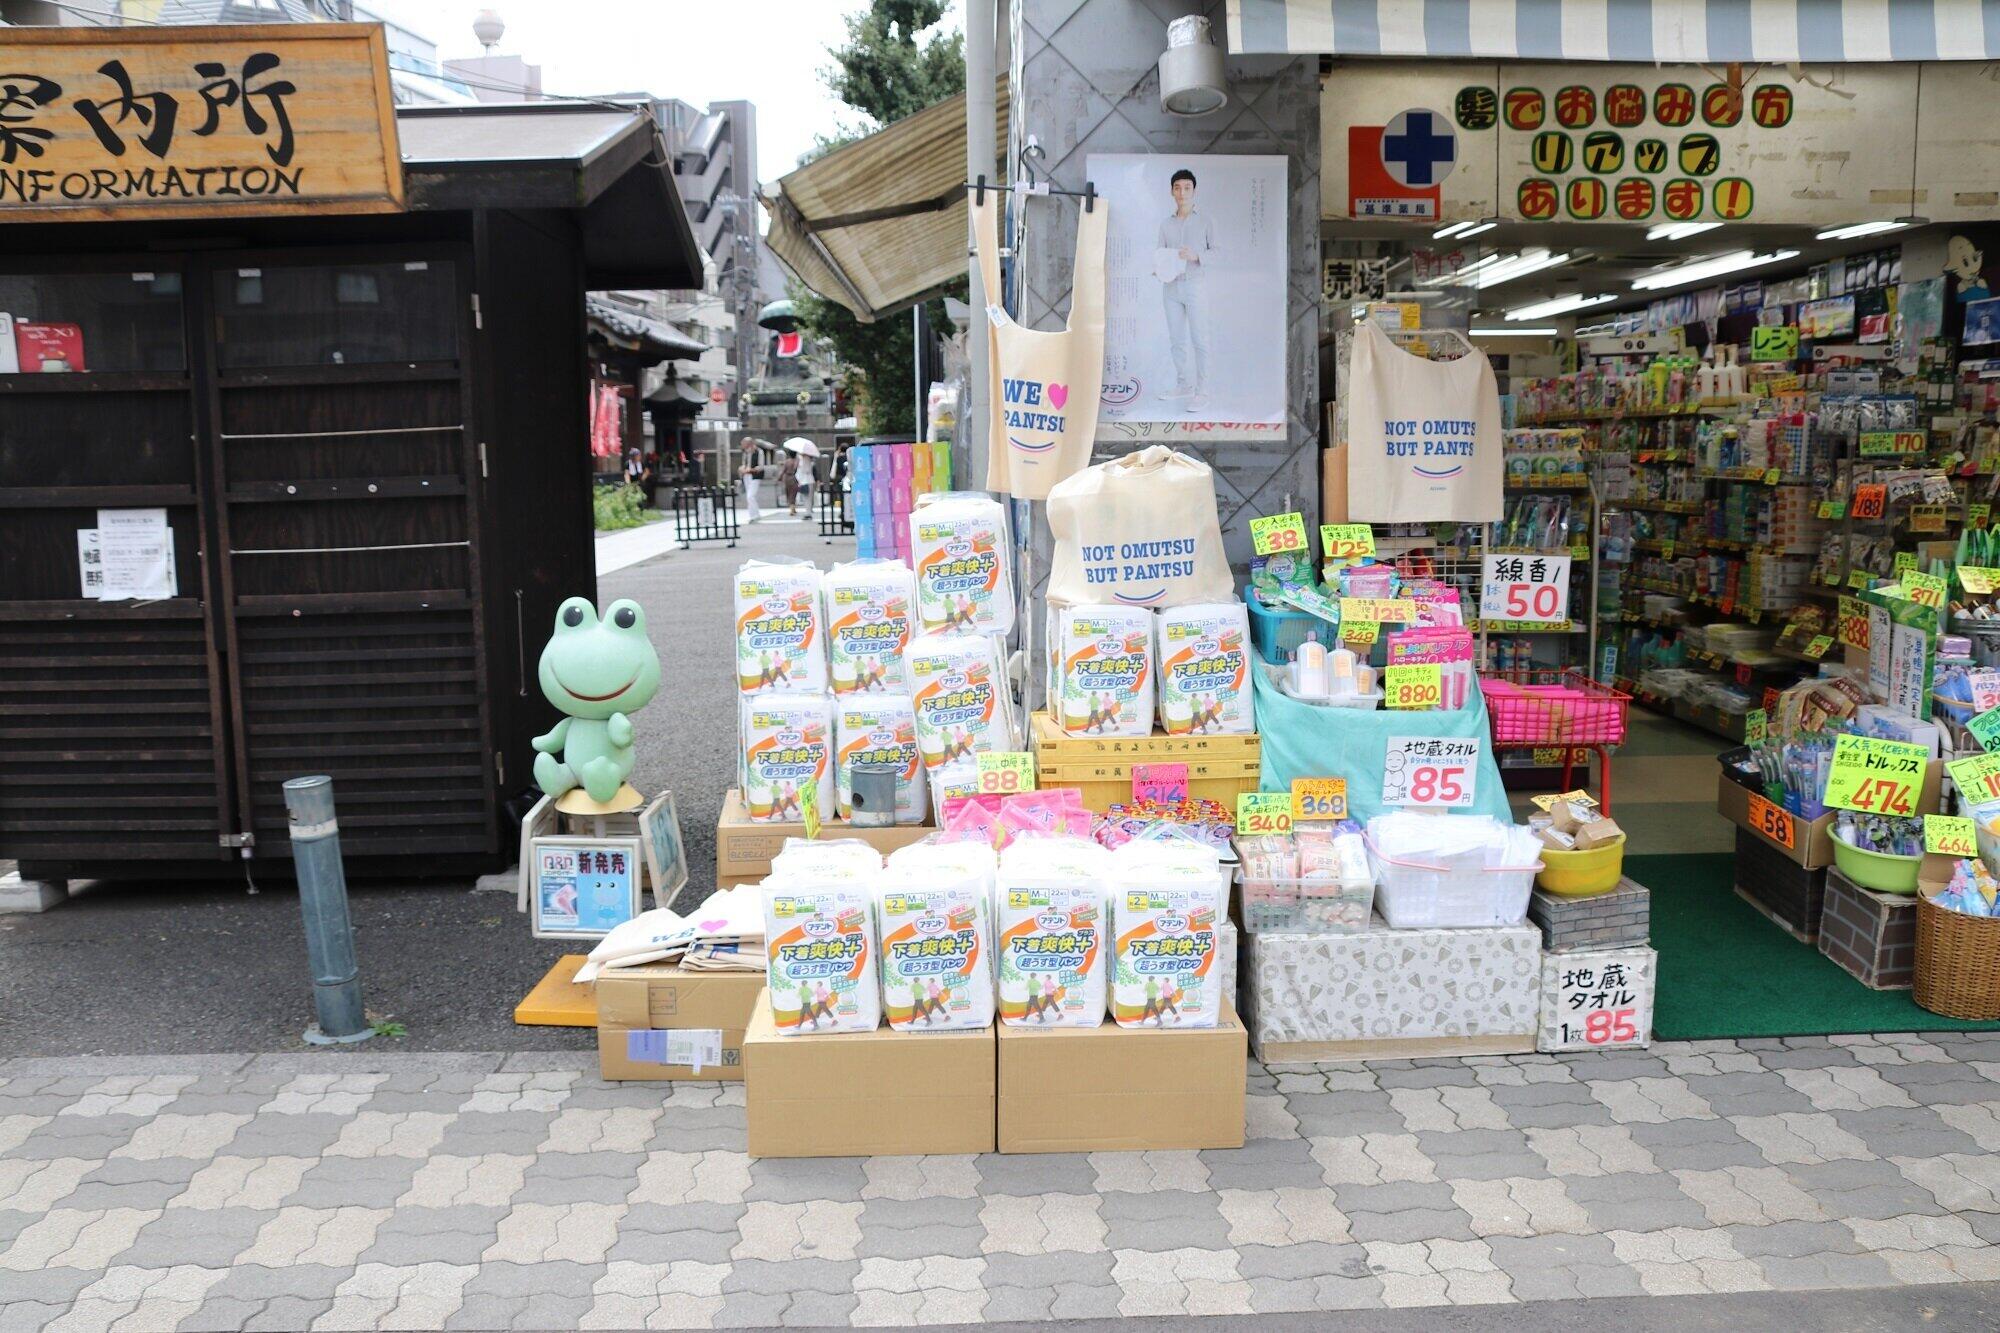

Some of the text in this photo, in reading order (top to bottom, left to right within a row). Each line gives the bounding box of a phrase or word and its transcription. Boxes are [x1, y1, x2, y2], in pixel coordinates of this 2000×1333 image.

[1539, 133, 1718, 174] リアップ
[1365, 203, 1425, 214] 基準薬局
[1327, 261, 1386, 299] 売場
[1755, 329, 1794, 350] レジ
[1003, 379, 1042, 405] WE
[1385, 421, 1417, 436] NOT
[1386, 441, 1418, 456] BUT
[1082, 538, 1195, 562] NOT OMUTSU
[1086, 560, 1194, 583] BUT PANTSU
[1405, 740, 1477, 756] 地蔵タオル
[1865, 753, 1919, 773] ドルックス
[578, 851, 625, 875] 新発売
[807, 921, 833, 932] アテント
[919, 918, 944, 929] アテント
[1041, 916, 1065, 924] アテント
[1159, 918, 1184, 927] アテント
[1562, 963, 1630, 990] 地蔵
[1568, 990, 1635, 1010] タオル
